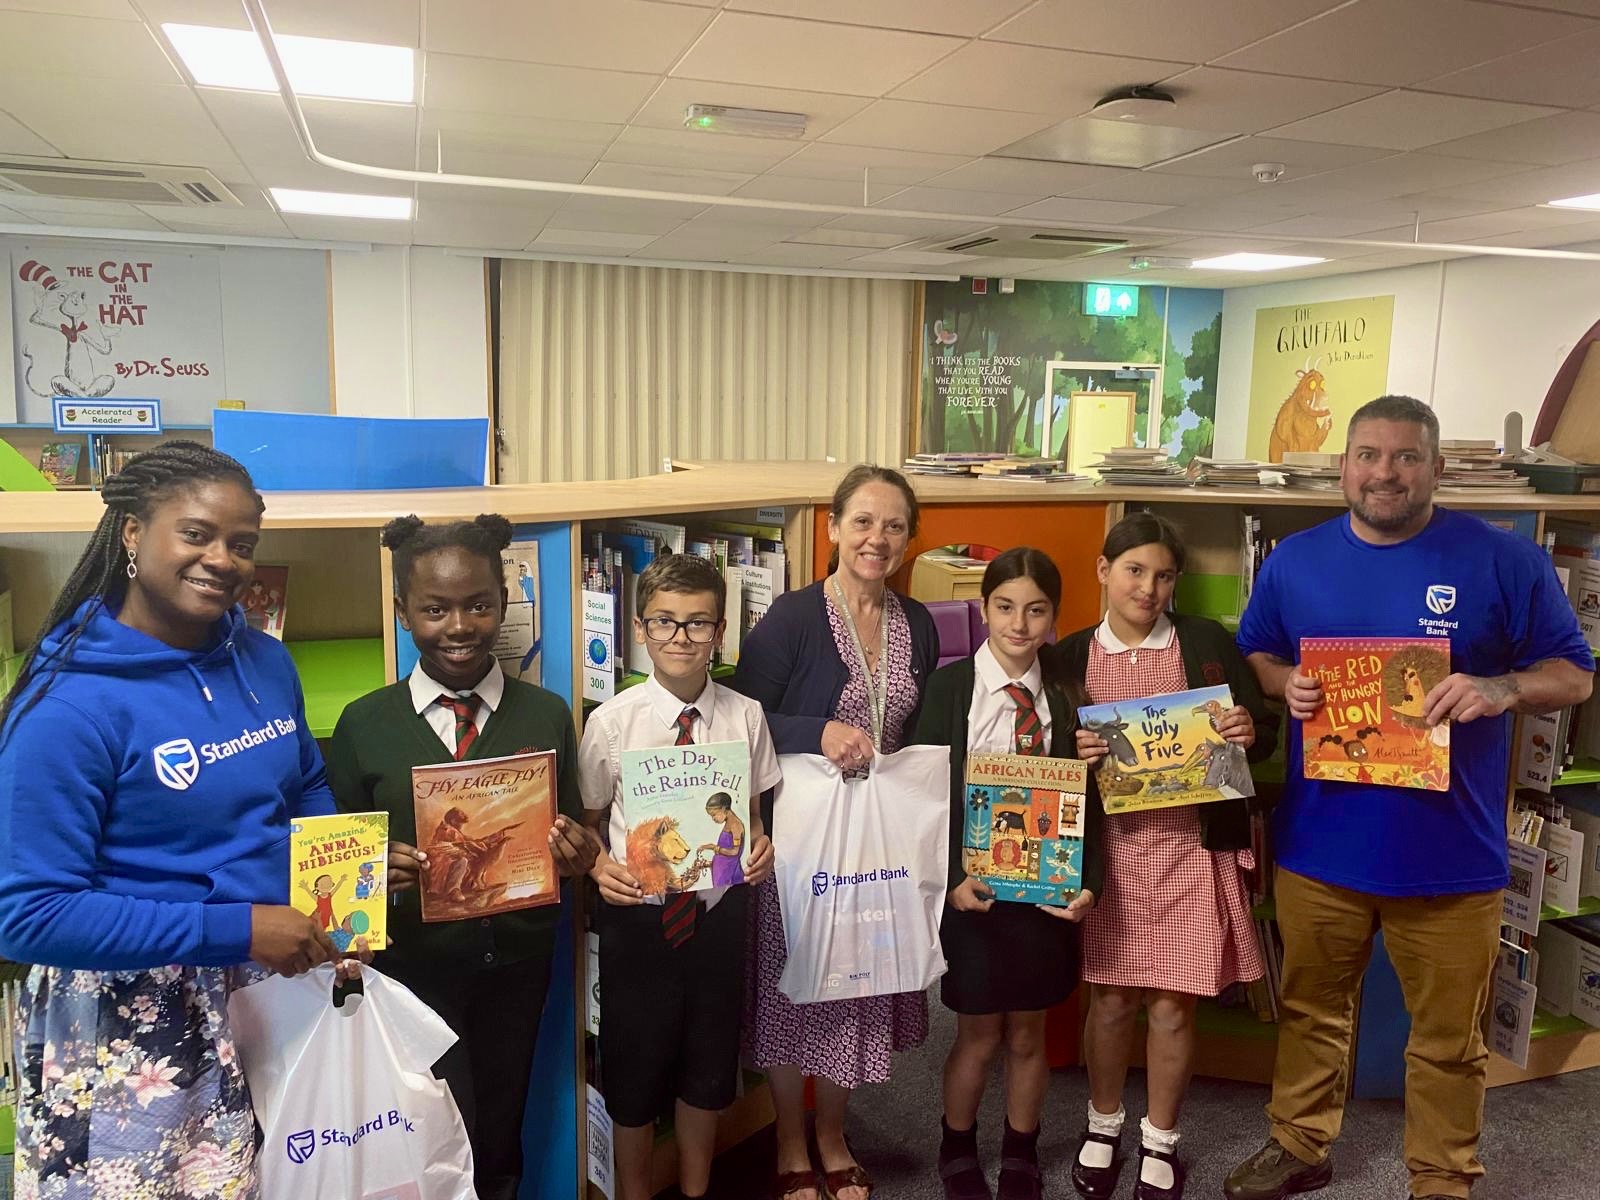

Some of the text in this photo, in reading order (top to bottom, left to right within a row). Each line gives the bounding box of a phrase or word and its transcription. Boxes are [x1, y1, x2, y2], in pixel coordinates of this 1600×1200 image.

[67, 261, 152, 284] THE CAT
[114, 284, 128, 293] IN
[109, 294, 133, 305] THE
[99, 304, 147, 326] HAT
[1295, 307, 1312, 323] THE
[1277, 317, 1366, 353] GRUFFALO
[115, 358, 210, 378] By Dr. Seuss
[936, 356, 963, 366] THINK
[977, 358, 991, 366] THE
[992, 355, 1021, 367] BOOKS
[944, 365, 1004, 376] THAT YOU READ
[935, 376, 955, 385] WHEN
[982, 375, 1012, 386] YOUNG
[938, 386, 1008, 395] THAT LIVE WITH YOU
[81, 408, 133, 416] Accelerated
[92, 416, 122, 425] Reader
[759, 510, 784, 519] DIVERSITY
[745, 569, 763, 579] Culture
[587, 599, 606, 610] Social
[585, 612, 612, 625] Sciences
[1418, 617, 1459, 630] Standard
[1426, 626, 1449, 636] Bank
[1346, 655, 1382, 680] RED
[590, 676, 605, 691] 300
[1328, 681, 1343, 690] AND
[1340, 677, 1382, 702] HUNGRY
[1142, 704, 1167, 720] The
[1326, 696, 1382, 731] LION
[1141, 719, 1179, 741] Ugly
[200, 720, 279, 764] Standard
[1140, 740, 1185, 762] Five
[638, 750, 717, 776] The Day
[461, 771, 511, 791] EAGLE,
[506, 765, 547, 787] FLY!
[972, 763, 1082, 783] AFRICAN TALES
[632, 771, 742, 797] the Rains Fell
[466, 790, 499, 800] AFRICAN
[298, 835, 326, 848] You're
[309, 836, 361, 857] ANNA
[298, 845, 376, 872] HIBISCUS!
[881, 866, 909, 881] Bank
[321, 1113, 383, 1147] Standard
